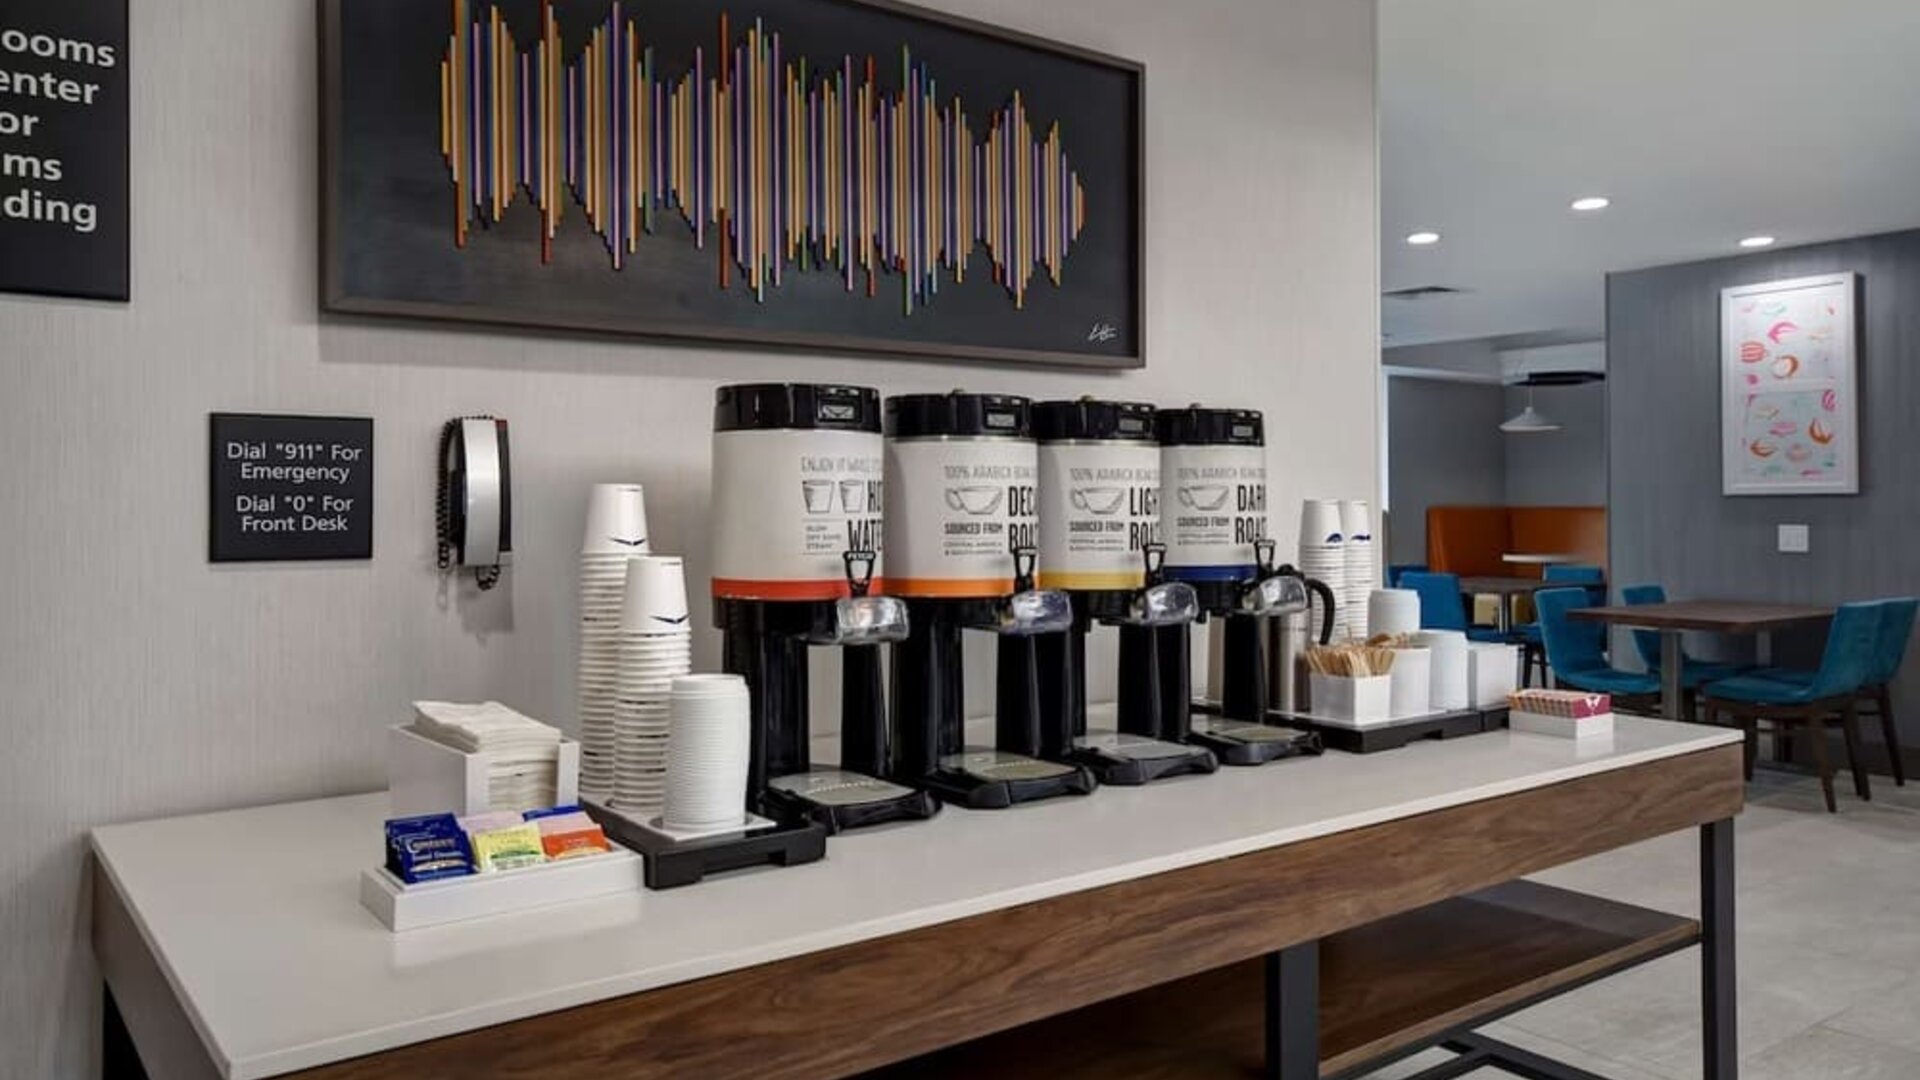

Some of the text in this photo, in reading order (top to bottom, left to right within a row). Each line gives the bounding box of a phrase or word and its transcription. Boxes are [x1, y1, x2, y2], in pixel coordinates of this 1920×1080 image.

[227, 442, 363, 461] Dial "911" For
[241, 462, 350, 485] Emergency
[236, 495, 354, 513] Dial "0" For
[242, 514, 348, 533] Front Desk
